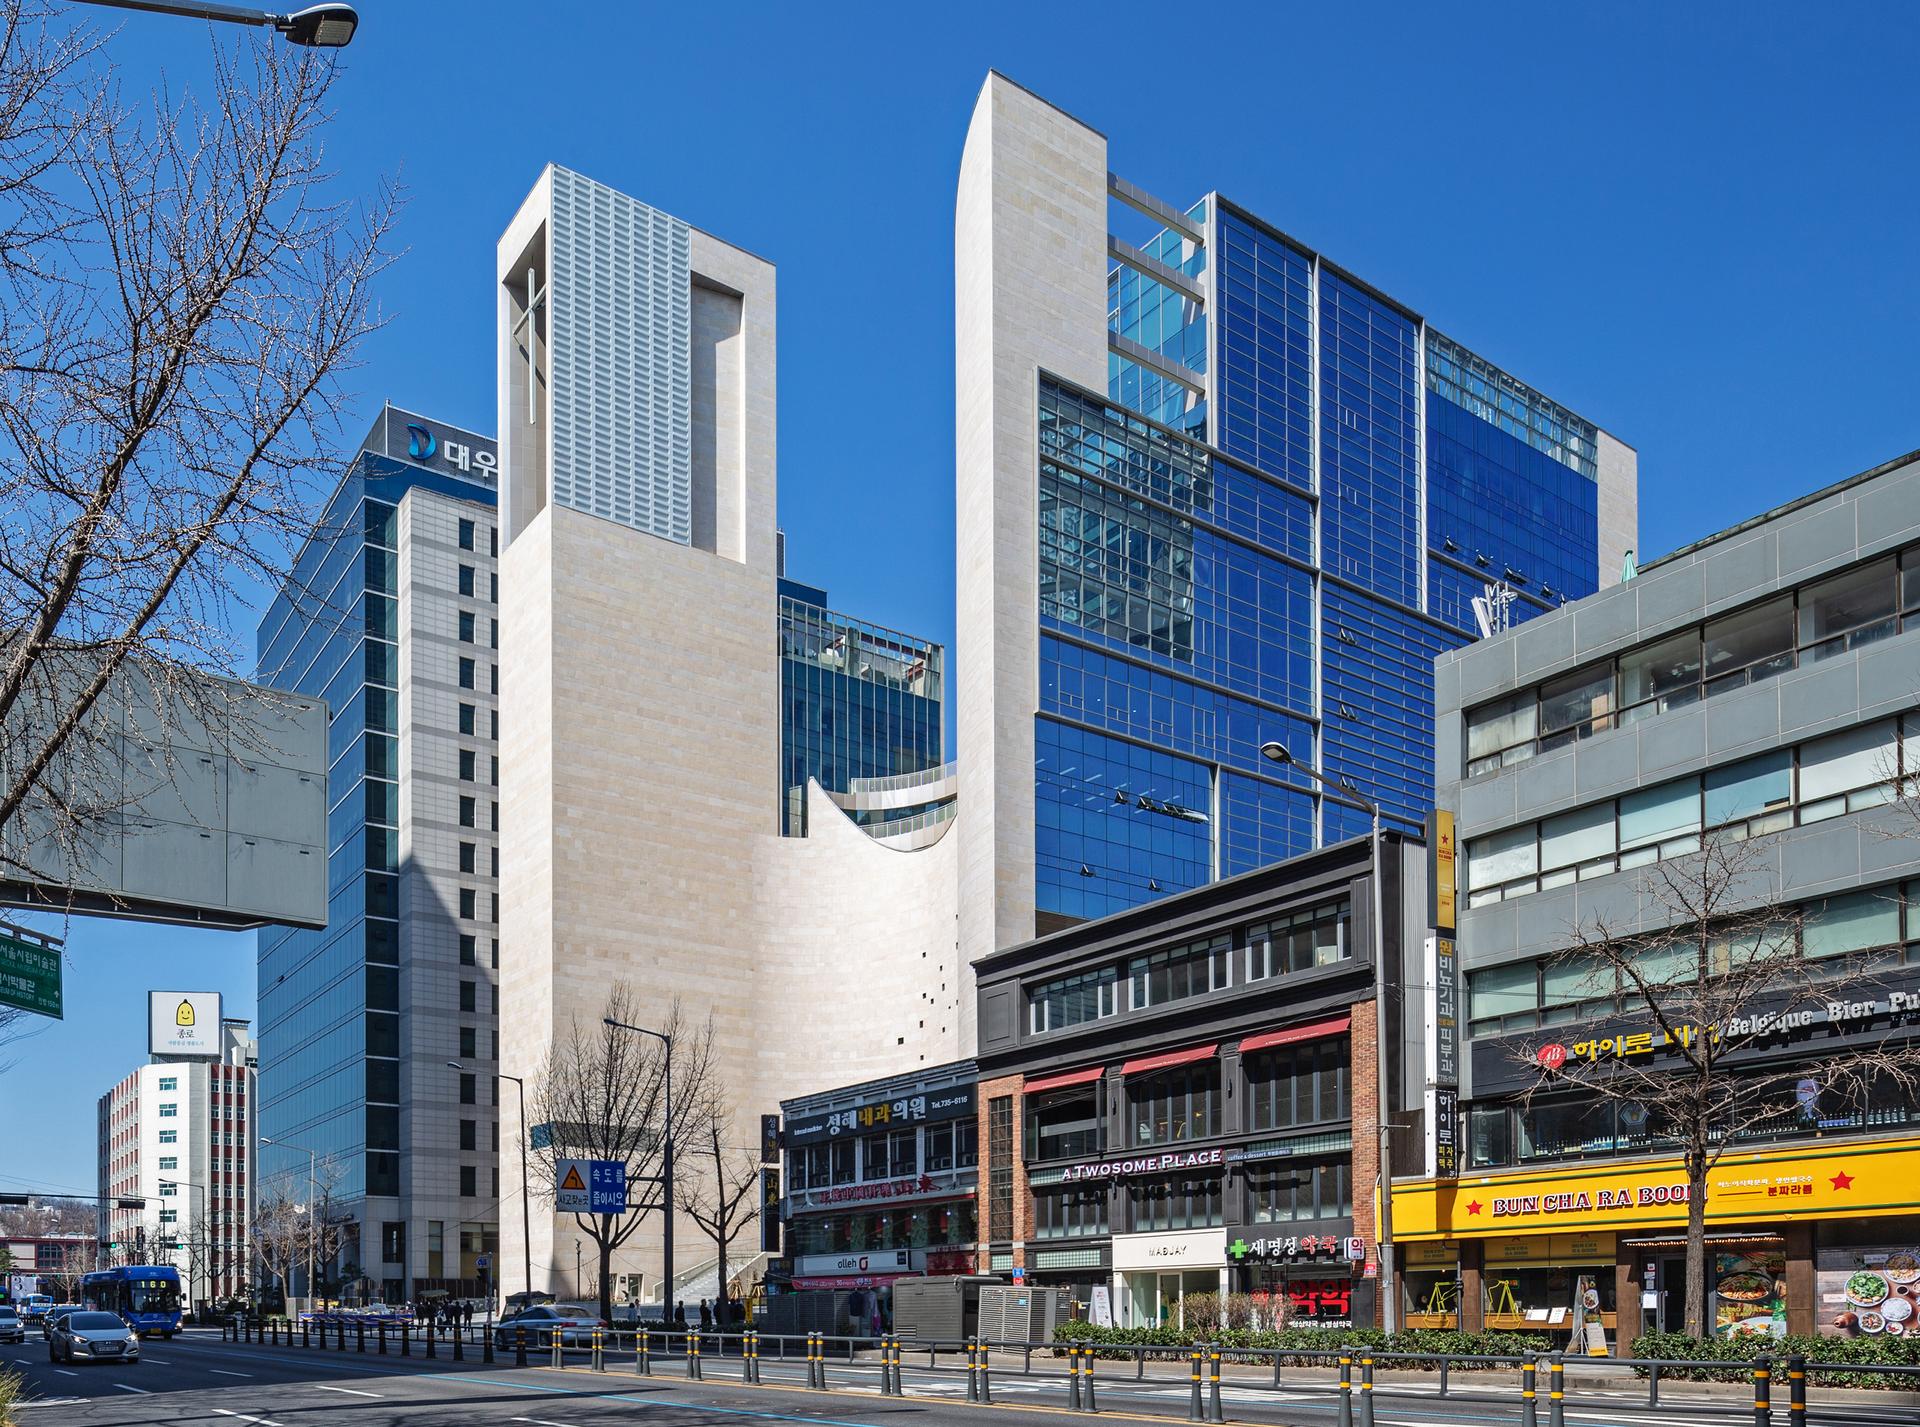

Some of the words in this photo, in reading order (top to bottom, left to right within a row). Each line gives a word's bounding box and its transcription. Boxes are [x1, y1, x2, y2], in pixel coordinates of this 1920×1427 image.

[1827, 999, 1876, 1022] Bier
[1889, 989, 1920, 1013] Pu
[1440, 1028, 1454, 1074] 피부과
[1573, 1032, 1655, 1062] 하이로
[1439, 1095, 1452, 1145] 하이로
[1438, 1146, 1454, 1157] 피자
[1062, 1168, 1073, 1181] A
[1073, 1158, 1157, 1180] TWOSOME
[1161, 1150, 1222, 1169] PLACE
[1438, 1158, 1454, 1169] 맥주
[592, 1191, 624, 1206] 줄이시오
[1493, 1196, 1539, 1216] BUN
[1544, 1192, 1592, 1211] CHA
[1597, 1189, 1634, 1208] RA
[1351, 1238, 1363, 1255] 약
[838, 1256, 857, 1269] olleh
[140, 1280, 166, 1289] 160
